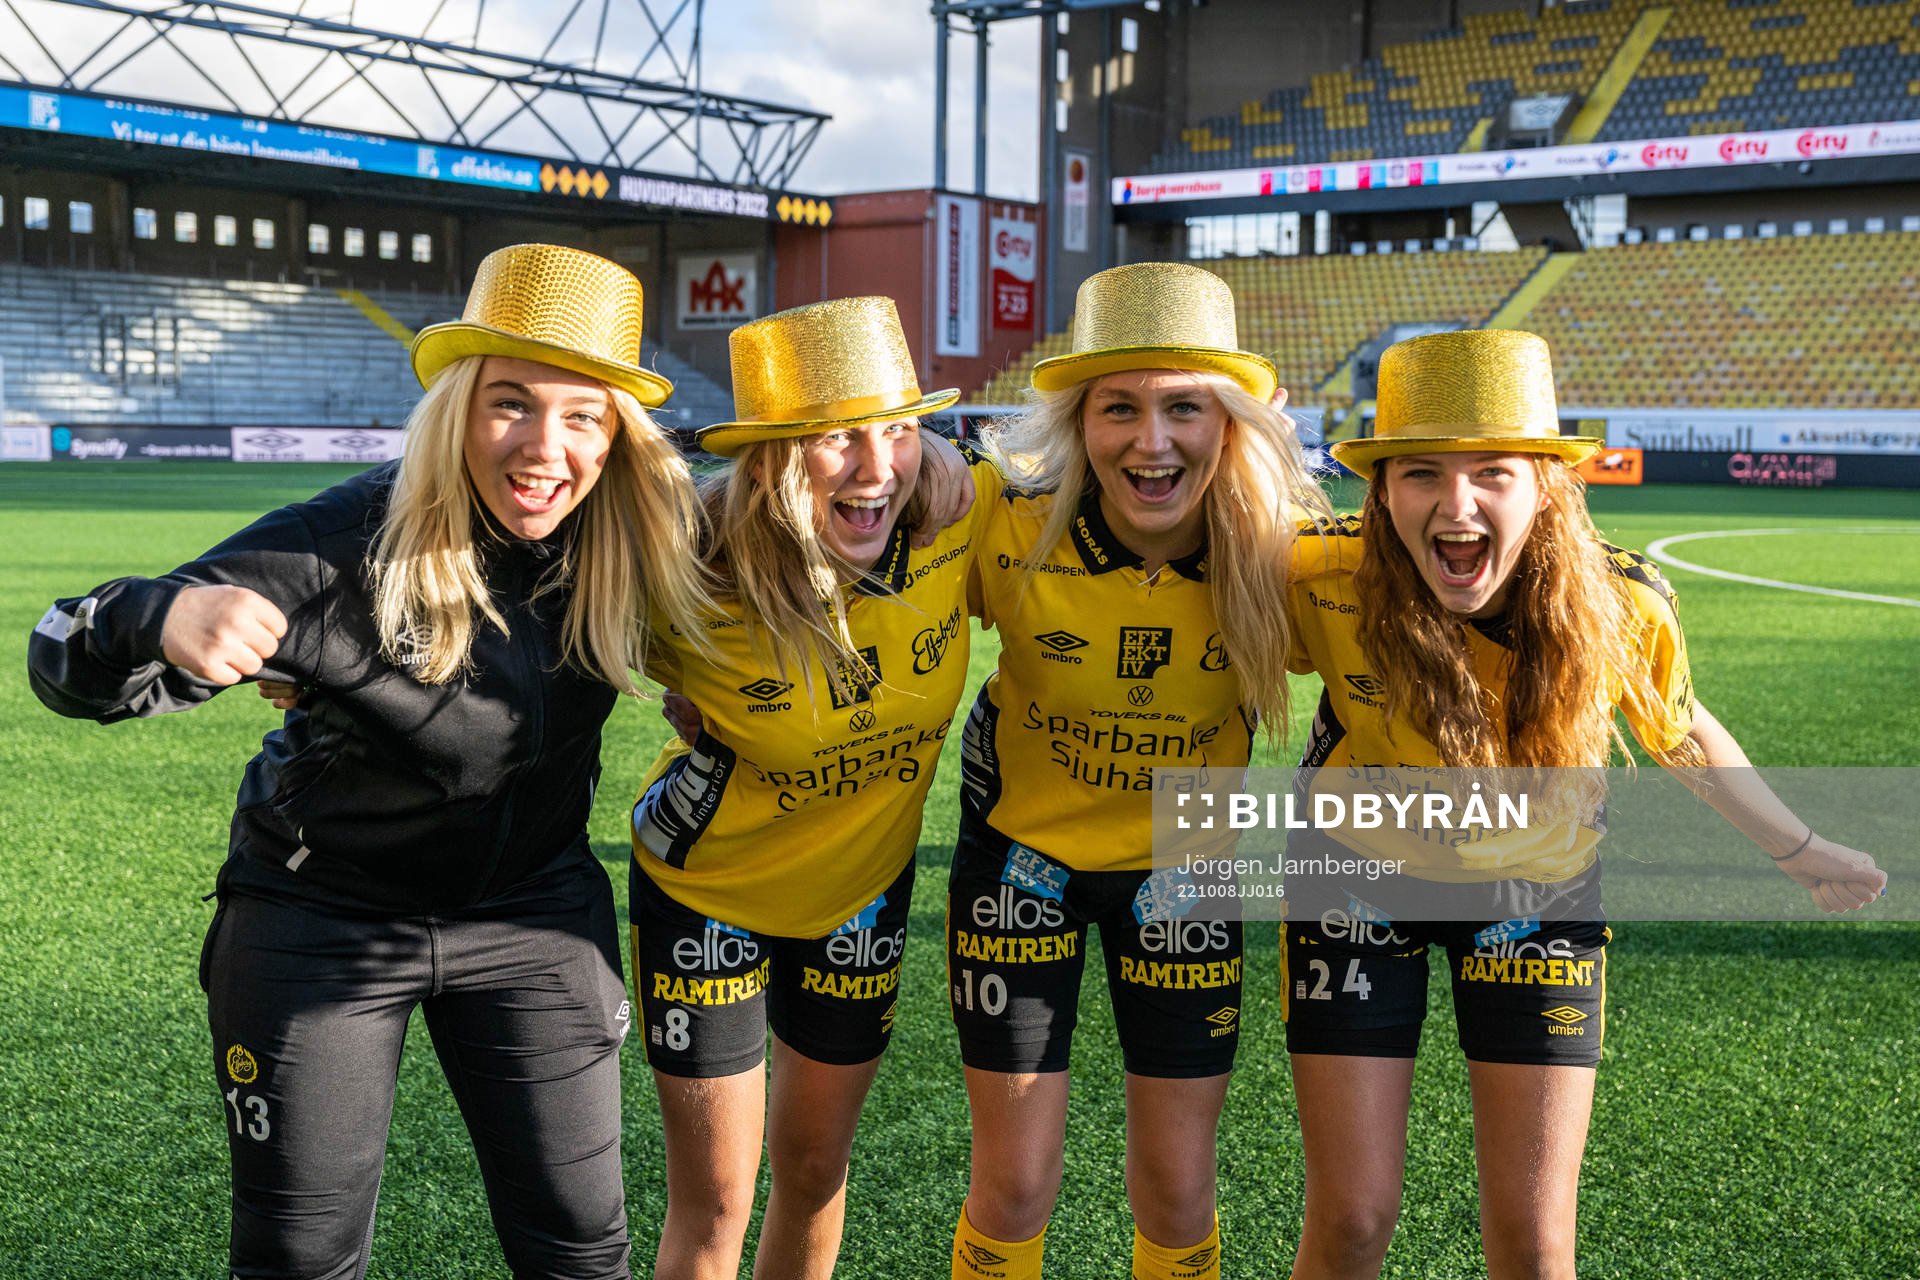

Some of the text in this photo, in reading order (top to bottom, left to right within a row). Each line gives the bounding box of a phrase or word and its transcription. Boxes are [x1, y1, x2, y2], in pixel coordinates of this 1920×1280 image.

[1641, 144, 1688, 168] City
[1719, 138, 1768, 162] City
[1797, 130, 1848, 158] City
[619, 175, 768, 218] HUVUDPARTNERS 2022
[998, 293, 1028, 315] 7-23
[1625, 425, 1753, 452] Sandwall
[1041, 652, 1083, 665] umbro
[747, 701, 792, 713] umbro
[1088, 708, 1188, 723] TOVEKS BIL
[812, 723, 916, 758] TOVEKS BIL
[1022, 701, 1228, 758] Sparbanke
[693, 760, 727, 821] interiör
[973, 886, 1065, 930] ellos
[673, 926, 759, 971] ellos
[826, 926, 906, 968] ellos
[957, 930, 1078, 964] RAMIRENT
[1139, 914, 1230, 954] ellos
[653, 957, 771, 1006] RAMIRENT
[1120, 956, 1242, 990] RAMIRENT
[1308, 958, 1372, 1000] 24
[1459, 955, 1595, 986] RAMIRENT
[961, 968, 1008, 1017] 10
[665, 1008, 690, 1052] 8
[1210, 1023, 1236, 1038] umbro
[1547, 1024, 1585, 1036] umbro
[226, 1087, 271, 1142] 13
